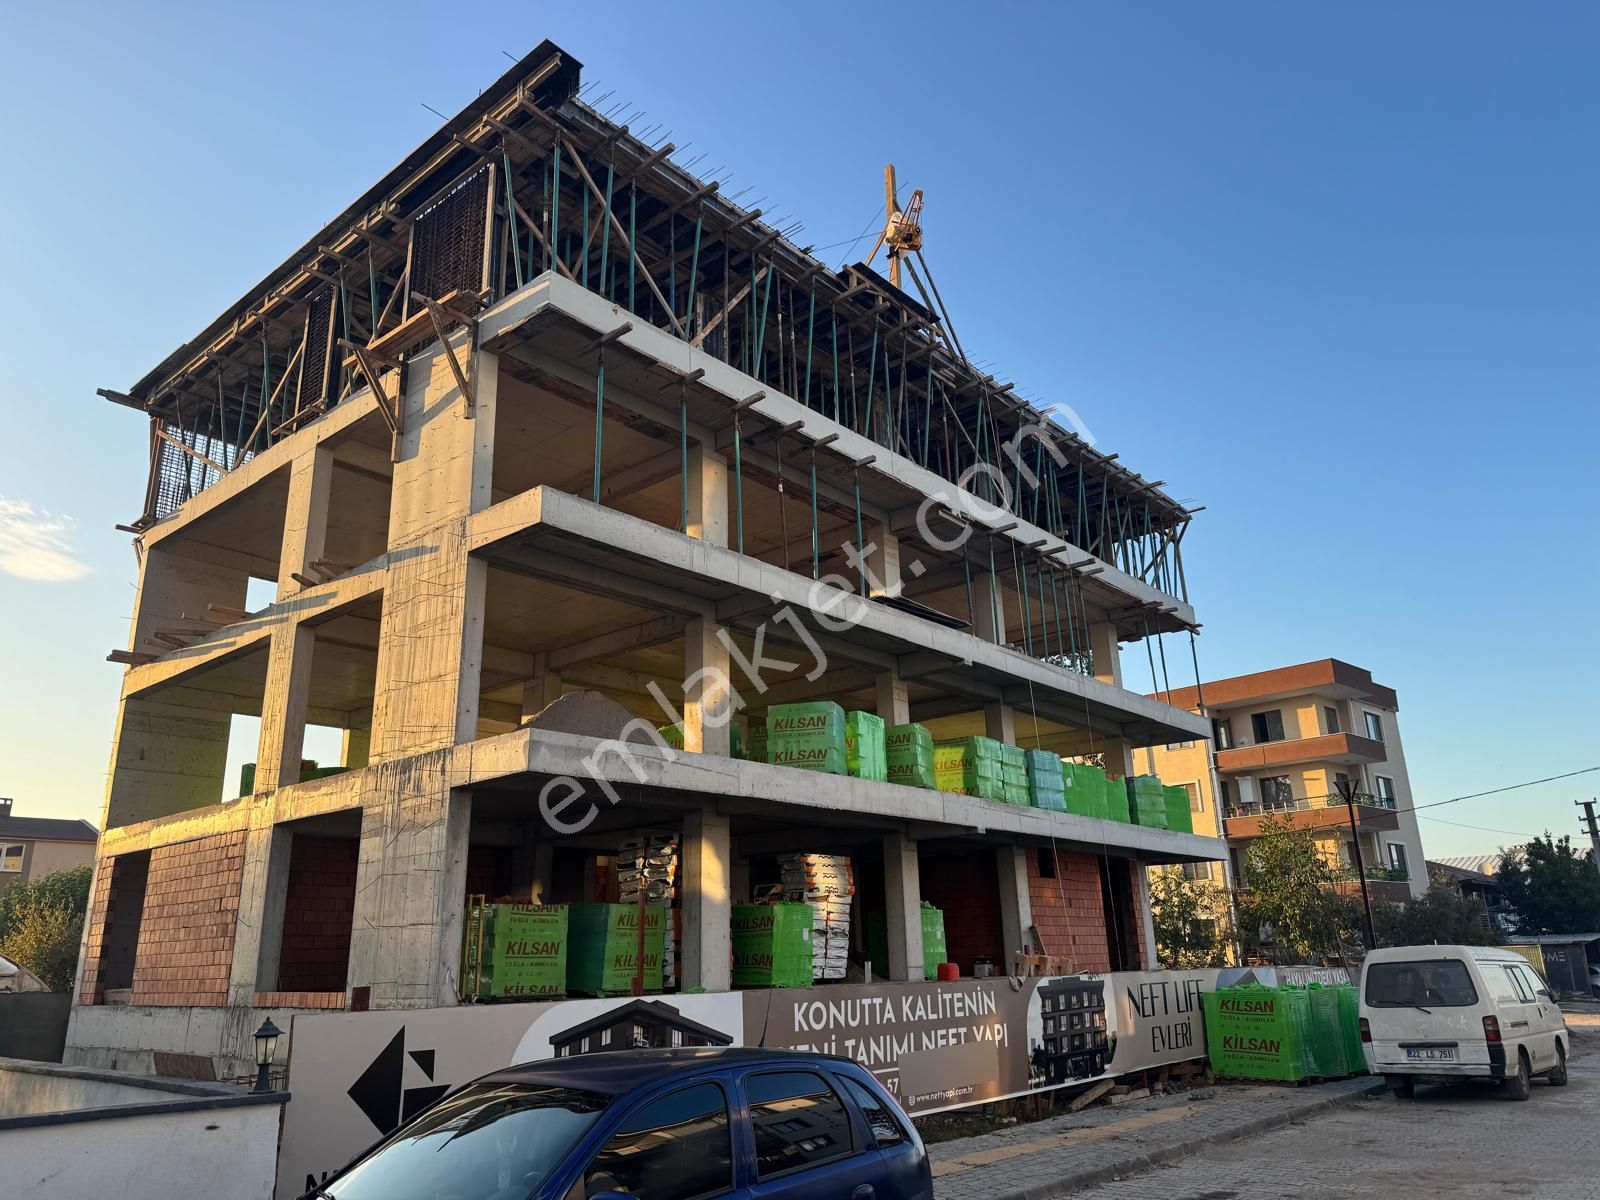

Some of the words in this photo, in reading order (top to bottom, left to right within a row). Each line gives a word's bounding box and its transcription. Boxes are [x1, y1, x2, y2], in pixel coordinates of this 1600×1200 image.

[774, 715, 827, 729] KİLSAN
[887, 733, 911, 745] SAN
[774, 748, 828, 762] KİLSAN
[888, 763, 914, 775] SAN
[506, 938, 560, 956] KİLSAN
[793, 996, 896, 1032] KONUTTA
[902, 986, 996, 1022] KALİTENİN
[1127, 982, 1169, 1020] NEFT
[1220, 997, 1275, 1013] KİLSAN
[1151, 1015, 1193, 1053] EVLERİ
[1223, 1034, 1281, 1053] KİLSAN
